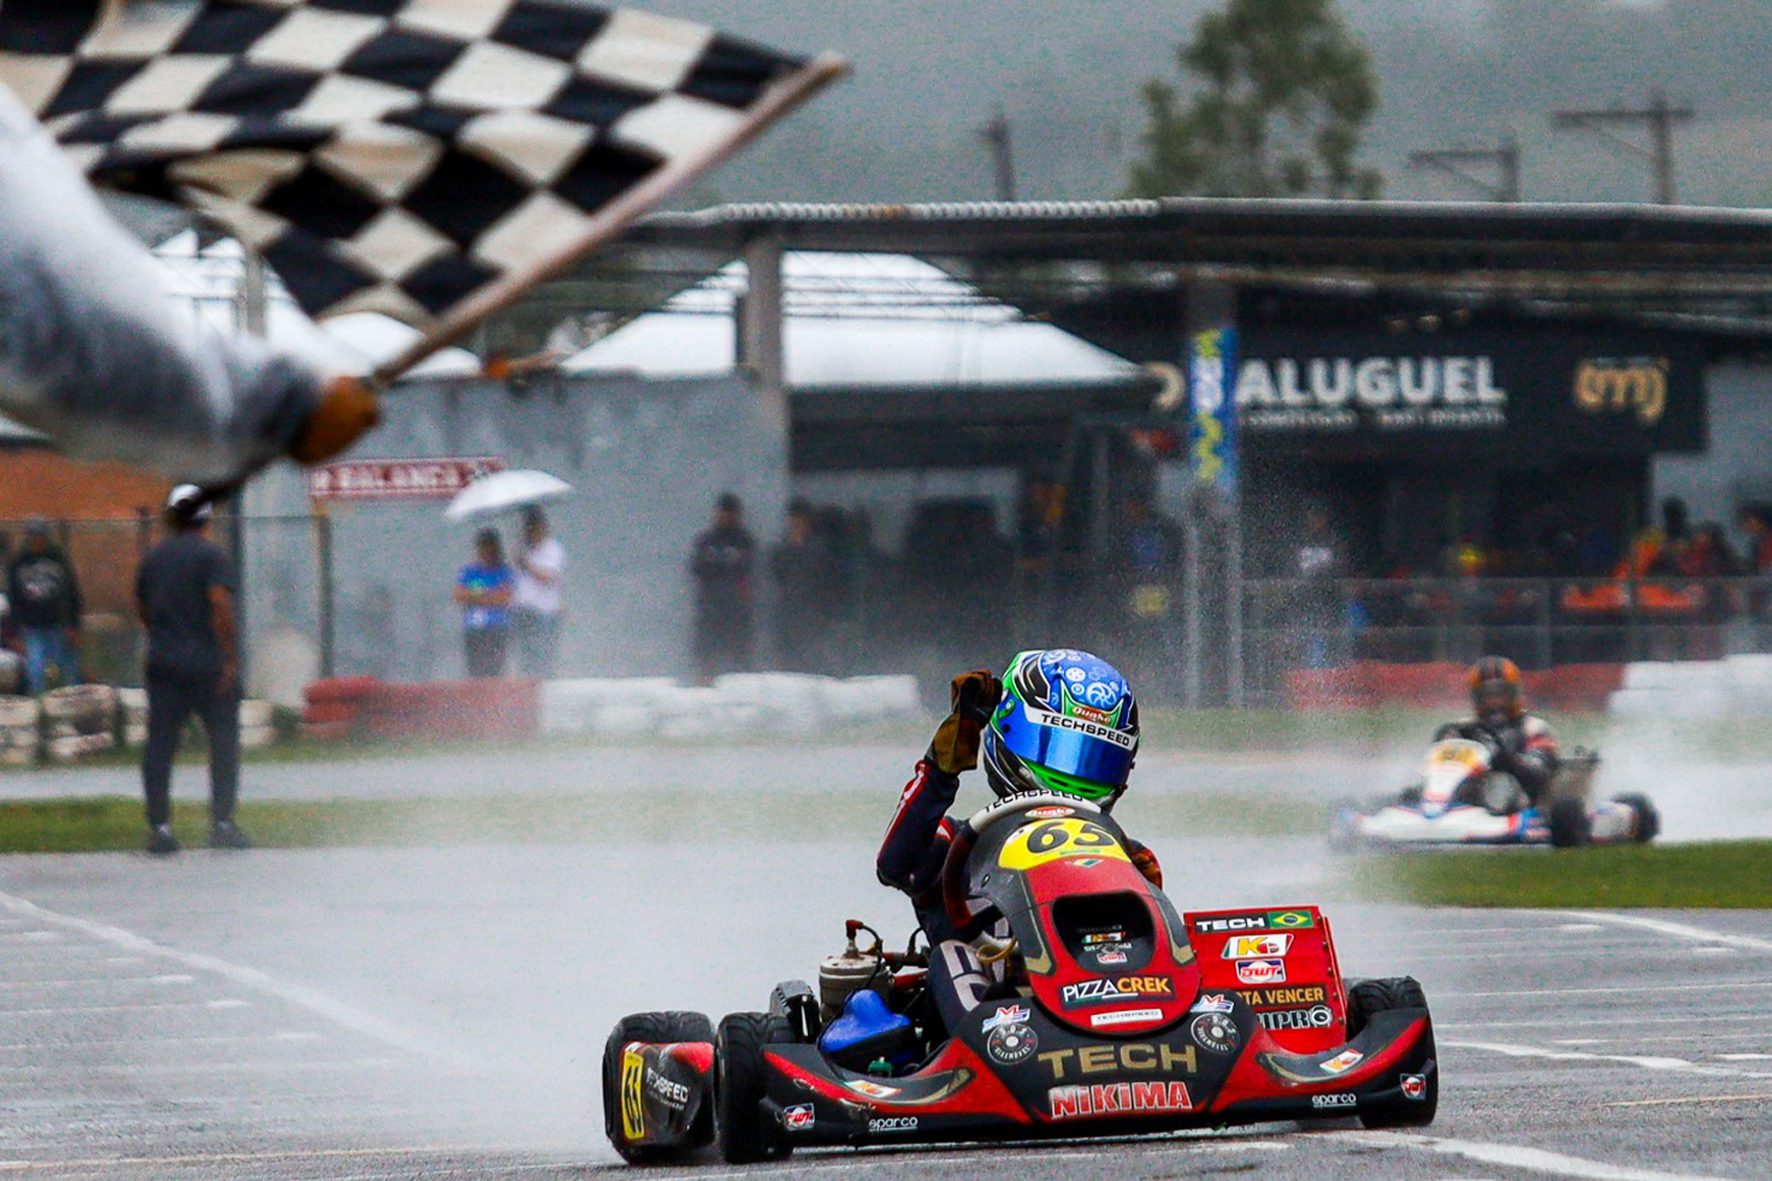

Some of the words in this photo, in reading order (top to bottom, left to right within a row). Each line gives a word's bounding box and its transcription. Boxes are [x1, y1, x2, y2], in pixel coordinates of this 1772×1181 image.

[1235, 356, 1507, 404] ALUGUEL
[1041, 713, 1130, 747] TECHSPEED
[1026, 821, 1116, 854] 65
[1196, 917, 1266, 932] TECH
[1062, 977, 1172, 1002] PIZZACREK
[1235, 991, 1263, 1006] TA
[1266, 987, 1324, 1004] VENCER
[1038, 1044, 1197, 1078] TECH
[1311, 1093, 1357, 1107] sparco
[868, 1116, 918, 1132] sparco
